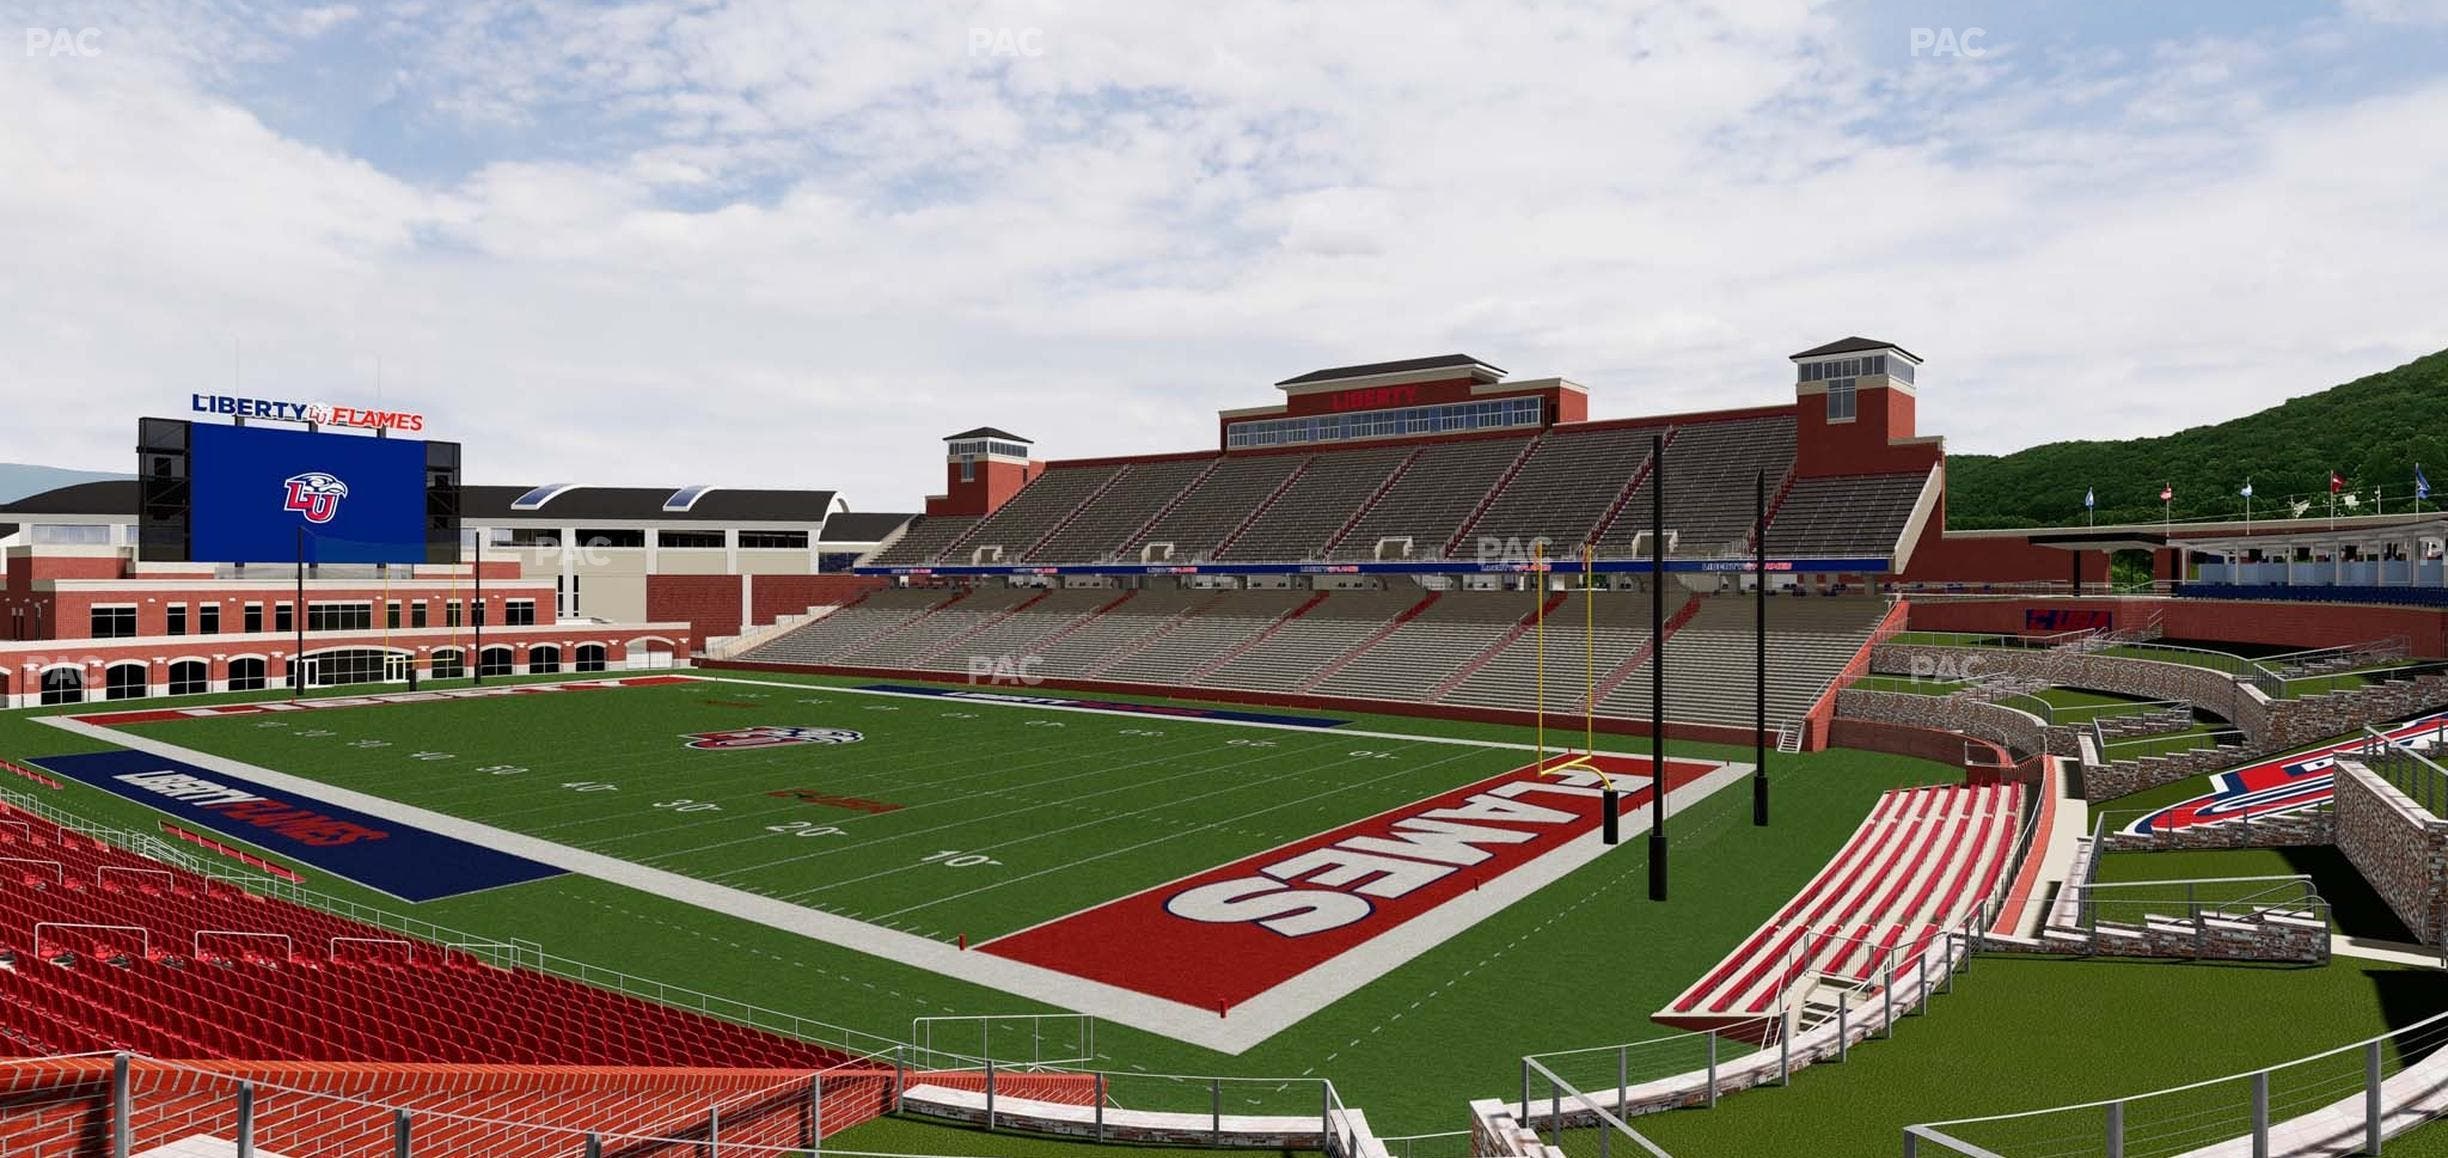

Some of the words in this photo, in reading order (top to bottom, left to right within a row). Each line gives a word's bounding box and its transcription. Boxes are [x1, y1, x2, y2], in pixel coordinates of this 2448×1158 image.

[1333, 385, 1417, 411] LIBERTY
[192, 393, 308, 420] LIBERTY
[332, 406, 423, 432] FLAMES
[284, 478, 340, 523] LU
[653, 799, 718, 811] 30
[765, 821, 840, 836] 20
[920, 850, 990, 867] 10
[1164, 768, 1656, 938] FLAMES
